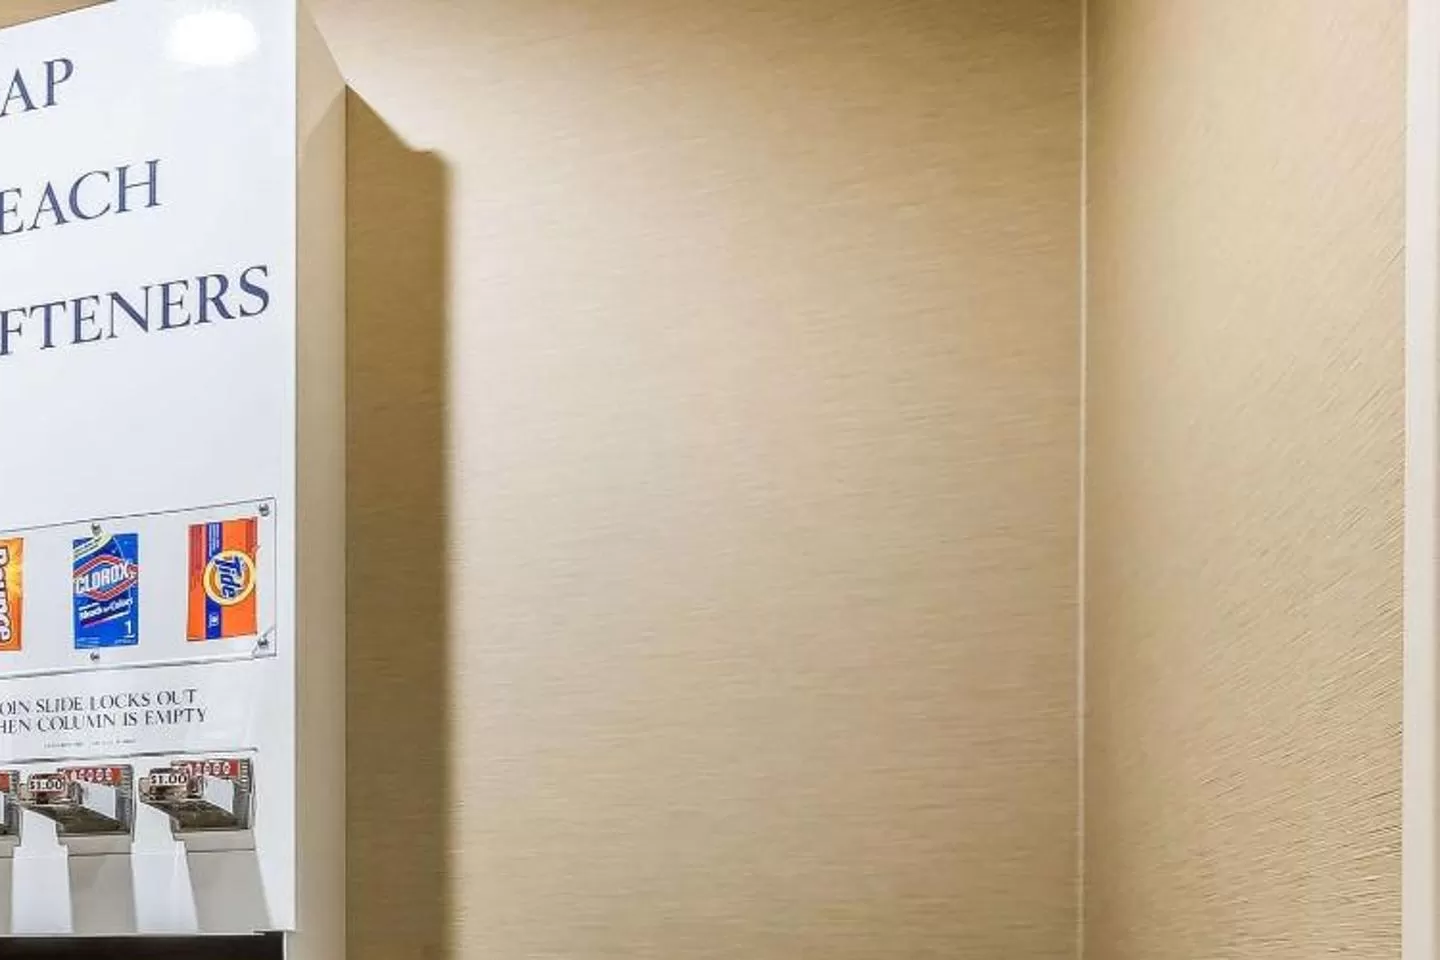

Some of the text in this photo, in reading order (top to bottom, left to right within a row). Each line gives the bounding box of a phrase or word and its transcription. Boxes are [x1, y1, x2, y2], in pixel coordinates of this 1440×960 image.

[76, 562, 129, 594] CLOROX
[214, 554, 244, 599] Tide
[36, 697, 84, 713] SLIDE
[90, 692, 152, 711] LOCKS
[156, 688, 198, 706] OUT
[37, 713, 116, 732] COLUMN
[123, 711, 138, 726] IS
[145, 707, 208, 726] EMPTY
[30, 778, 63, 791] $1.00
[151, 774, 188, 785] $1.00
